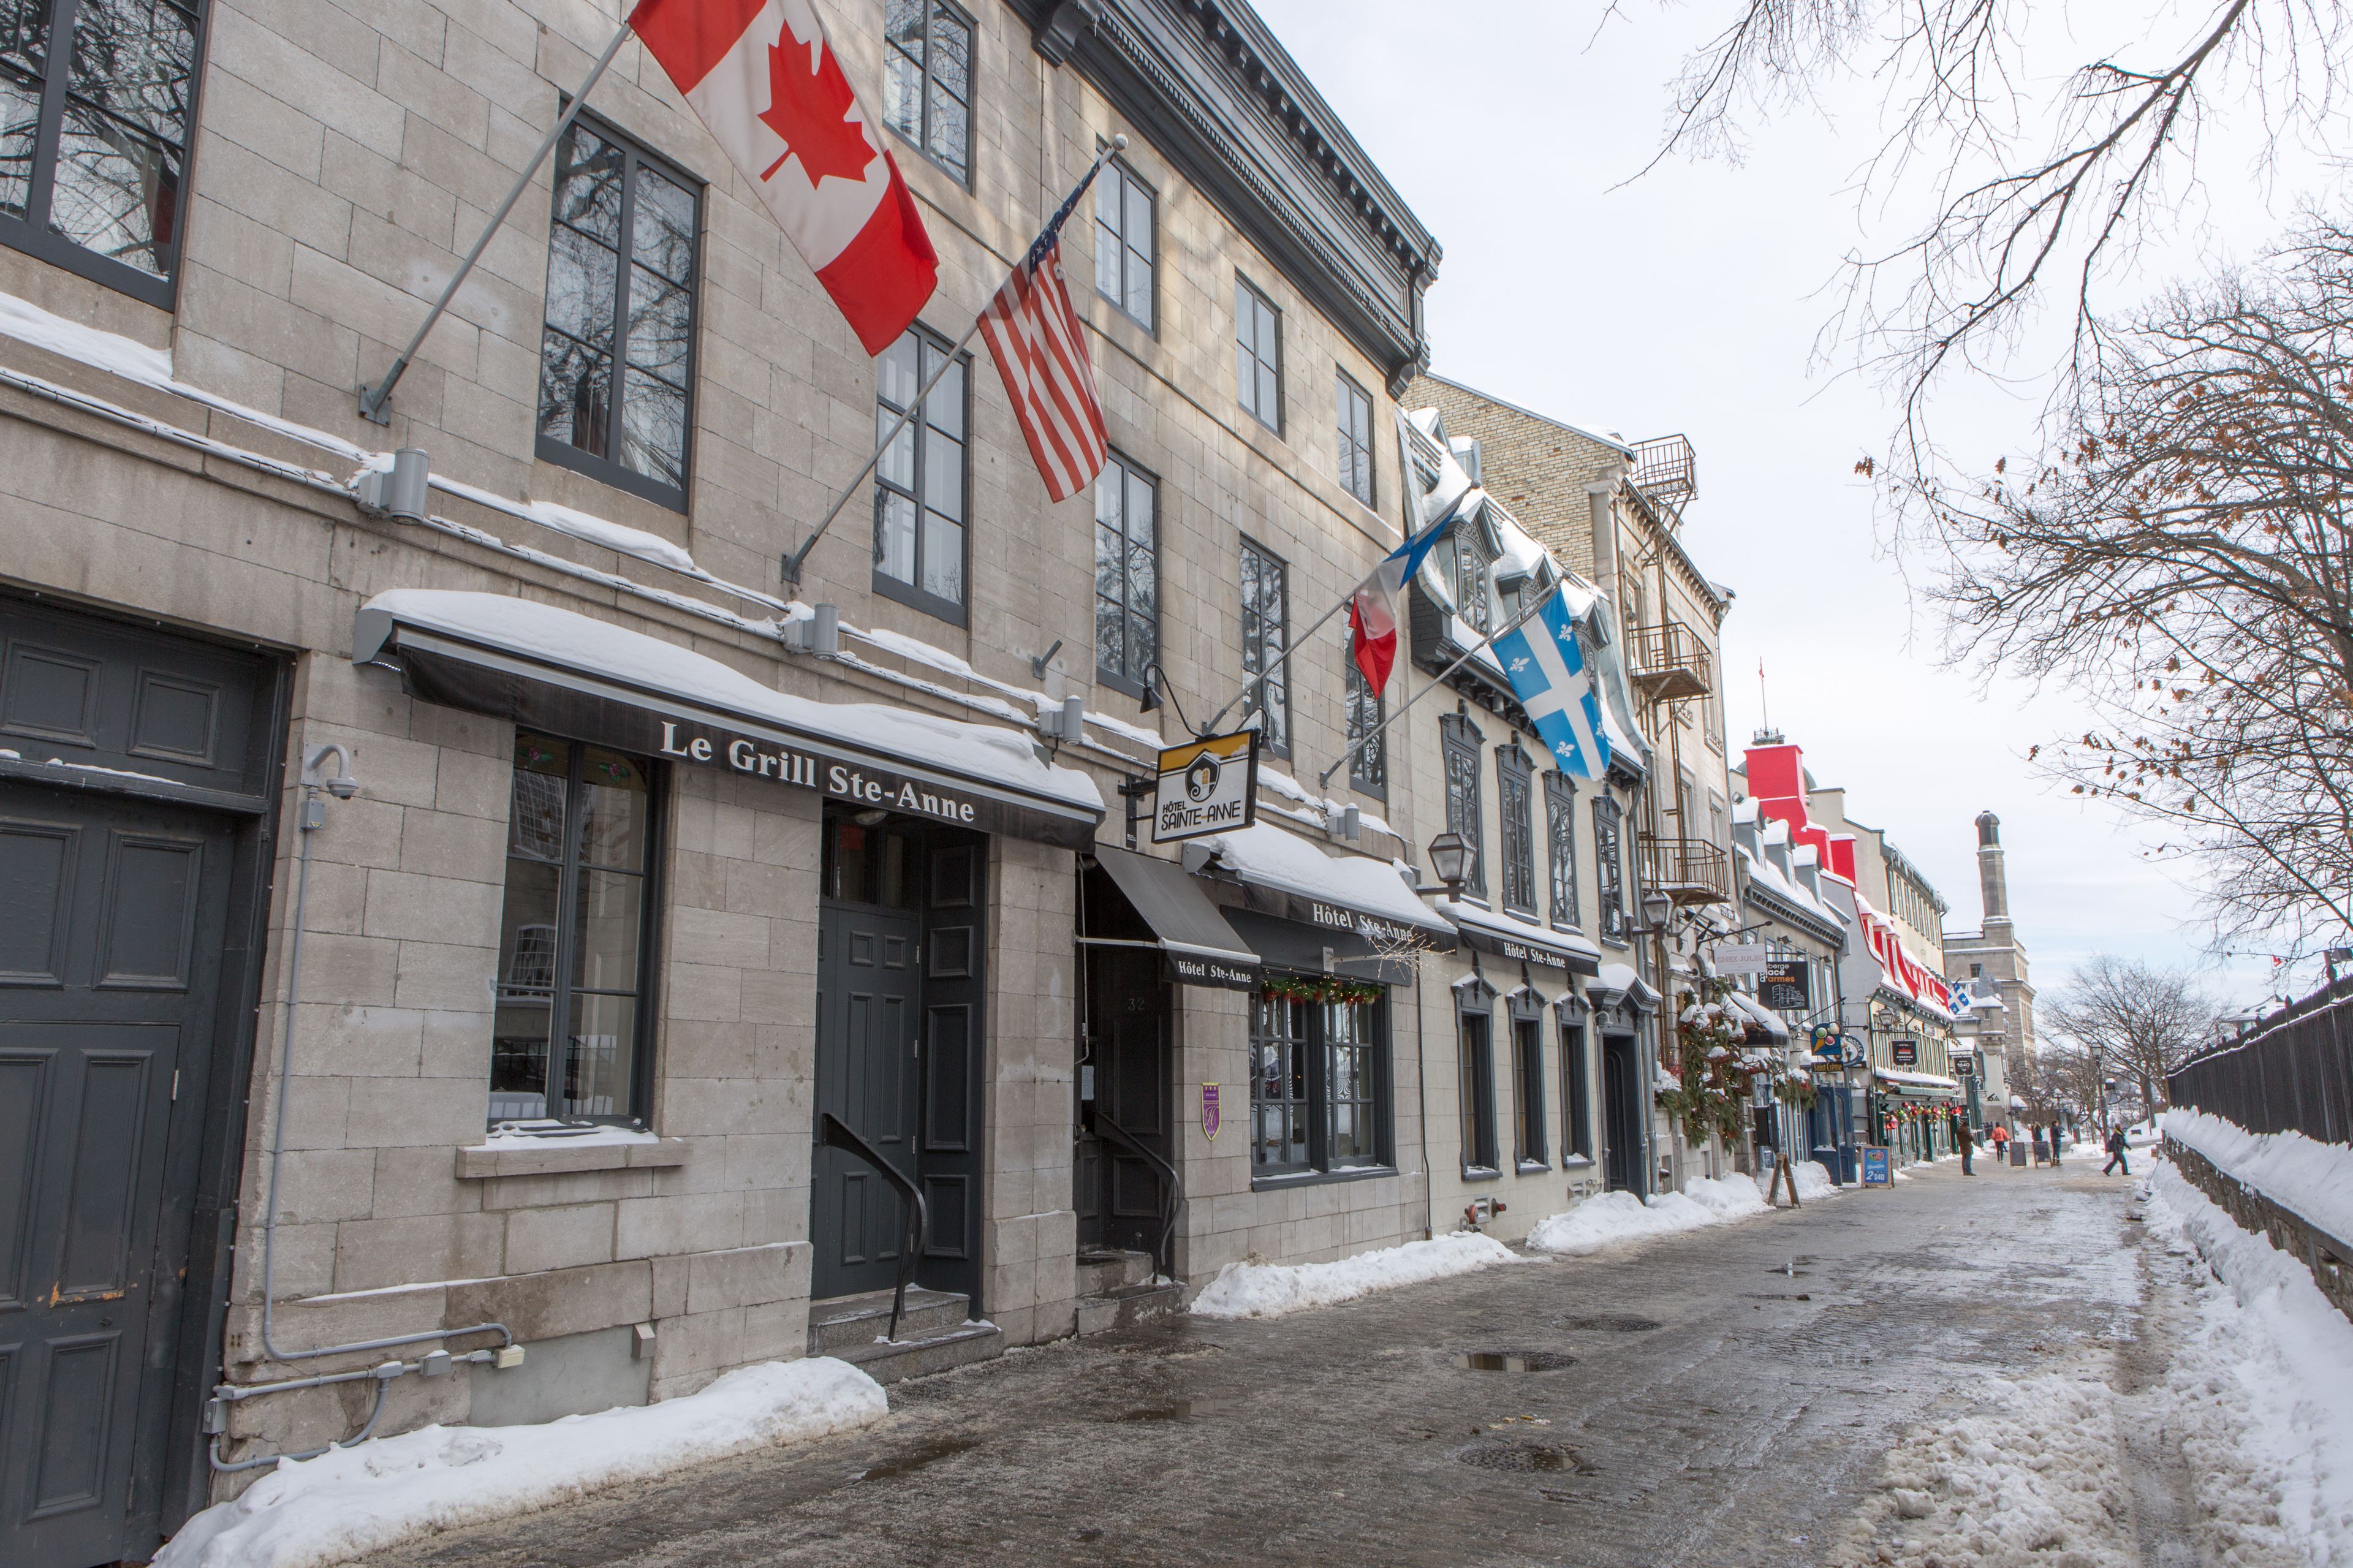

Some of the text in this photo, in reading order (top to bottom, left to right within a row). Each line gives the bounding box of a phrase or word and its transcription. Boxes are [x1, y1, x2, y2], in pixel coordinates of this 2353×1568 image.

[660, 721, 974, 822] Le Grill Ste-Anne
[1161, 800, 1241, 831] SAINTE-ANNE
[1162, 800, 1187, 814] HÔTEL
[1313, 903, 1412, 942] Hôtel Ste-Anne
[1504, 942, 1566, 968] Hôtel Ste-Anne
[1178, 961, 1251, 983] Hôtel Ste-Anne
[1128, 996, 1145, 1010] 32
[1865, 1170, 1874, 1180] 2
